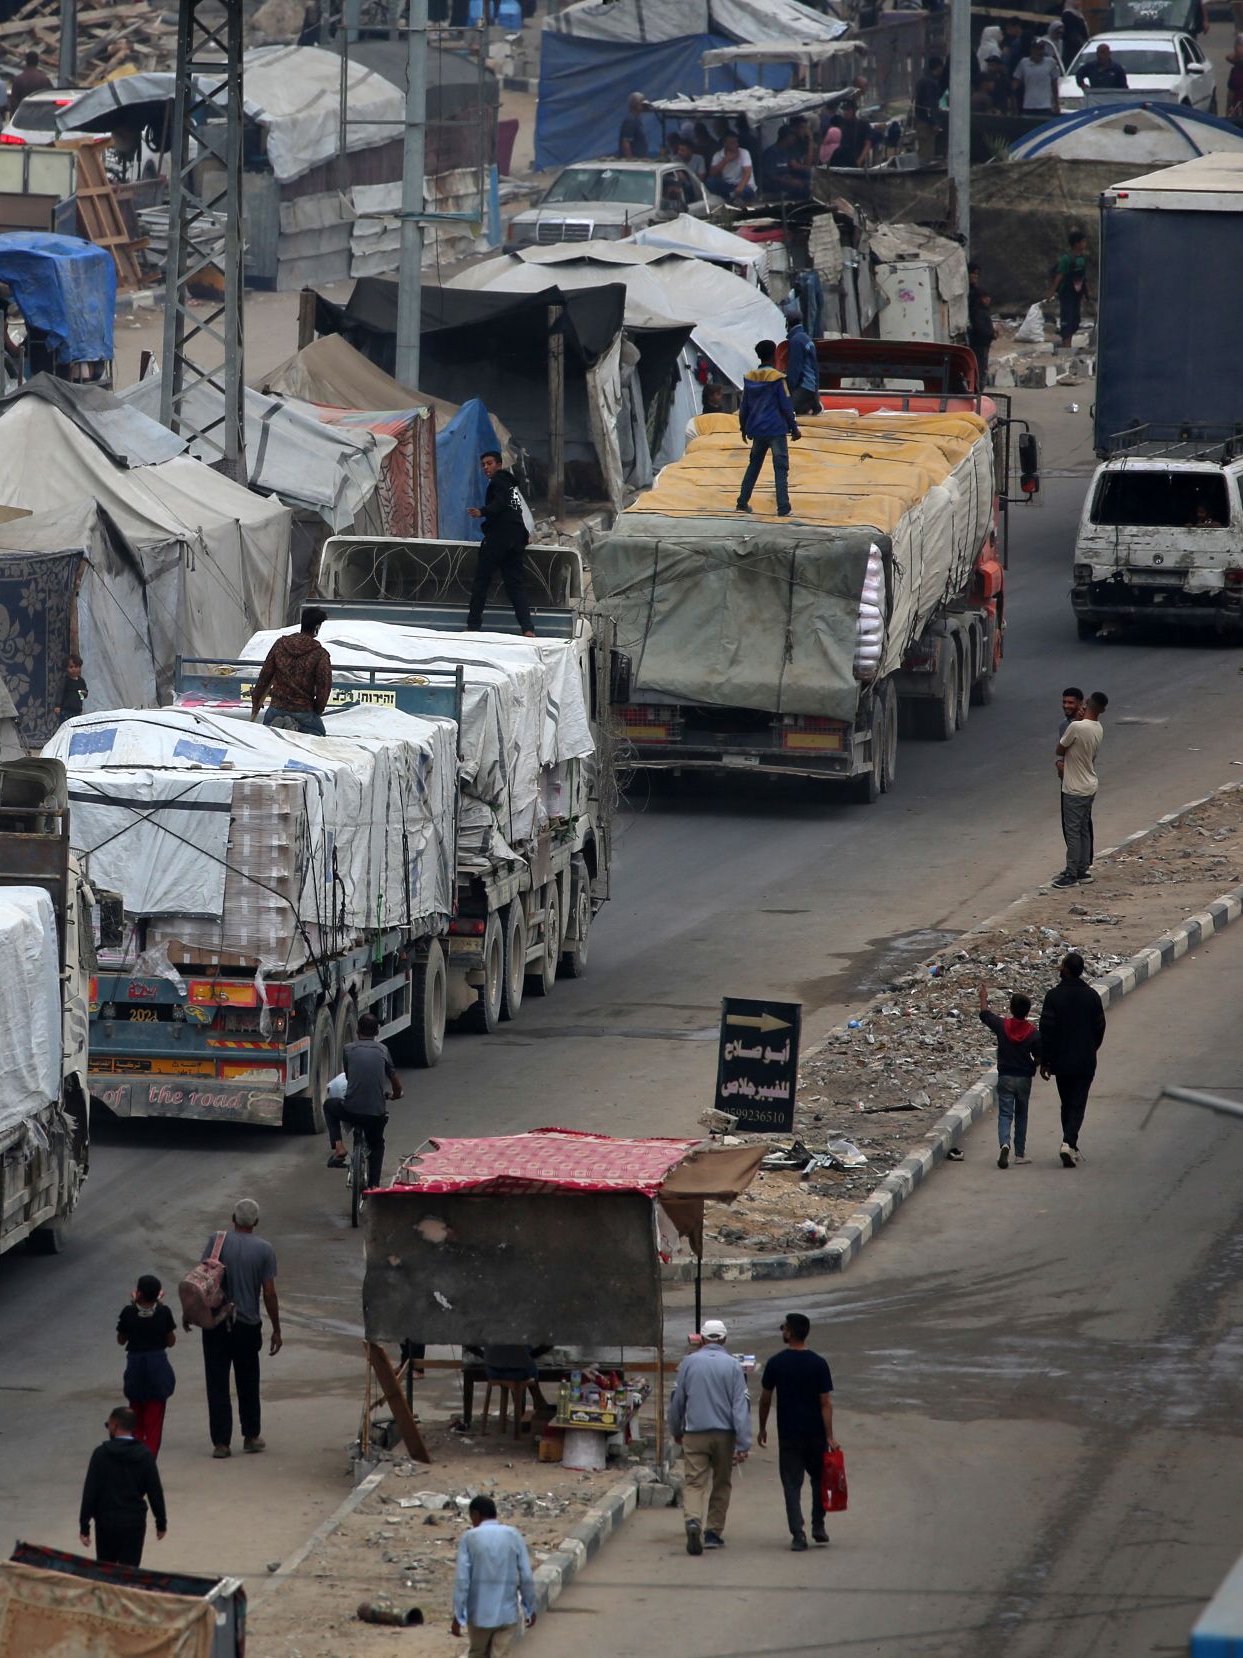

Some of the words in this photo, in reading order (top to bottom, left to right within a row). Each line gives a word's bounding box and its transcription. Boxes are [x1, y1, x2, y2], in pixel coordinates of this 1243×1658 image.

[724, 1039, 763, 1061] صلاح
[762, 1038, 791, 1065] أبو
[148, 1084, 184, 1105] the
[188, 1090, 249, 1109] road
